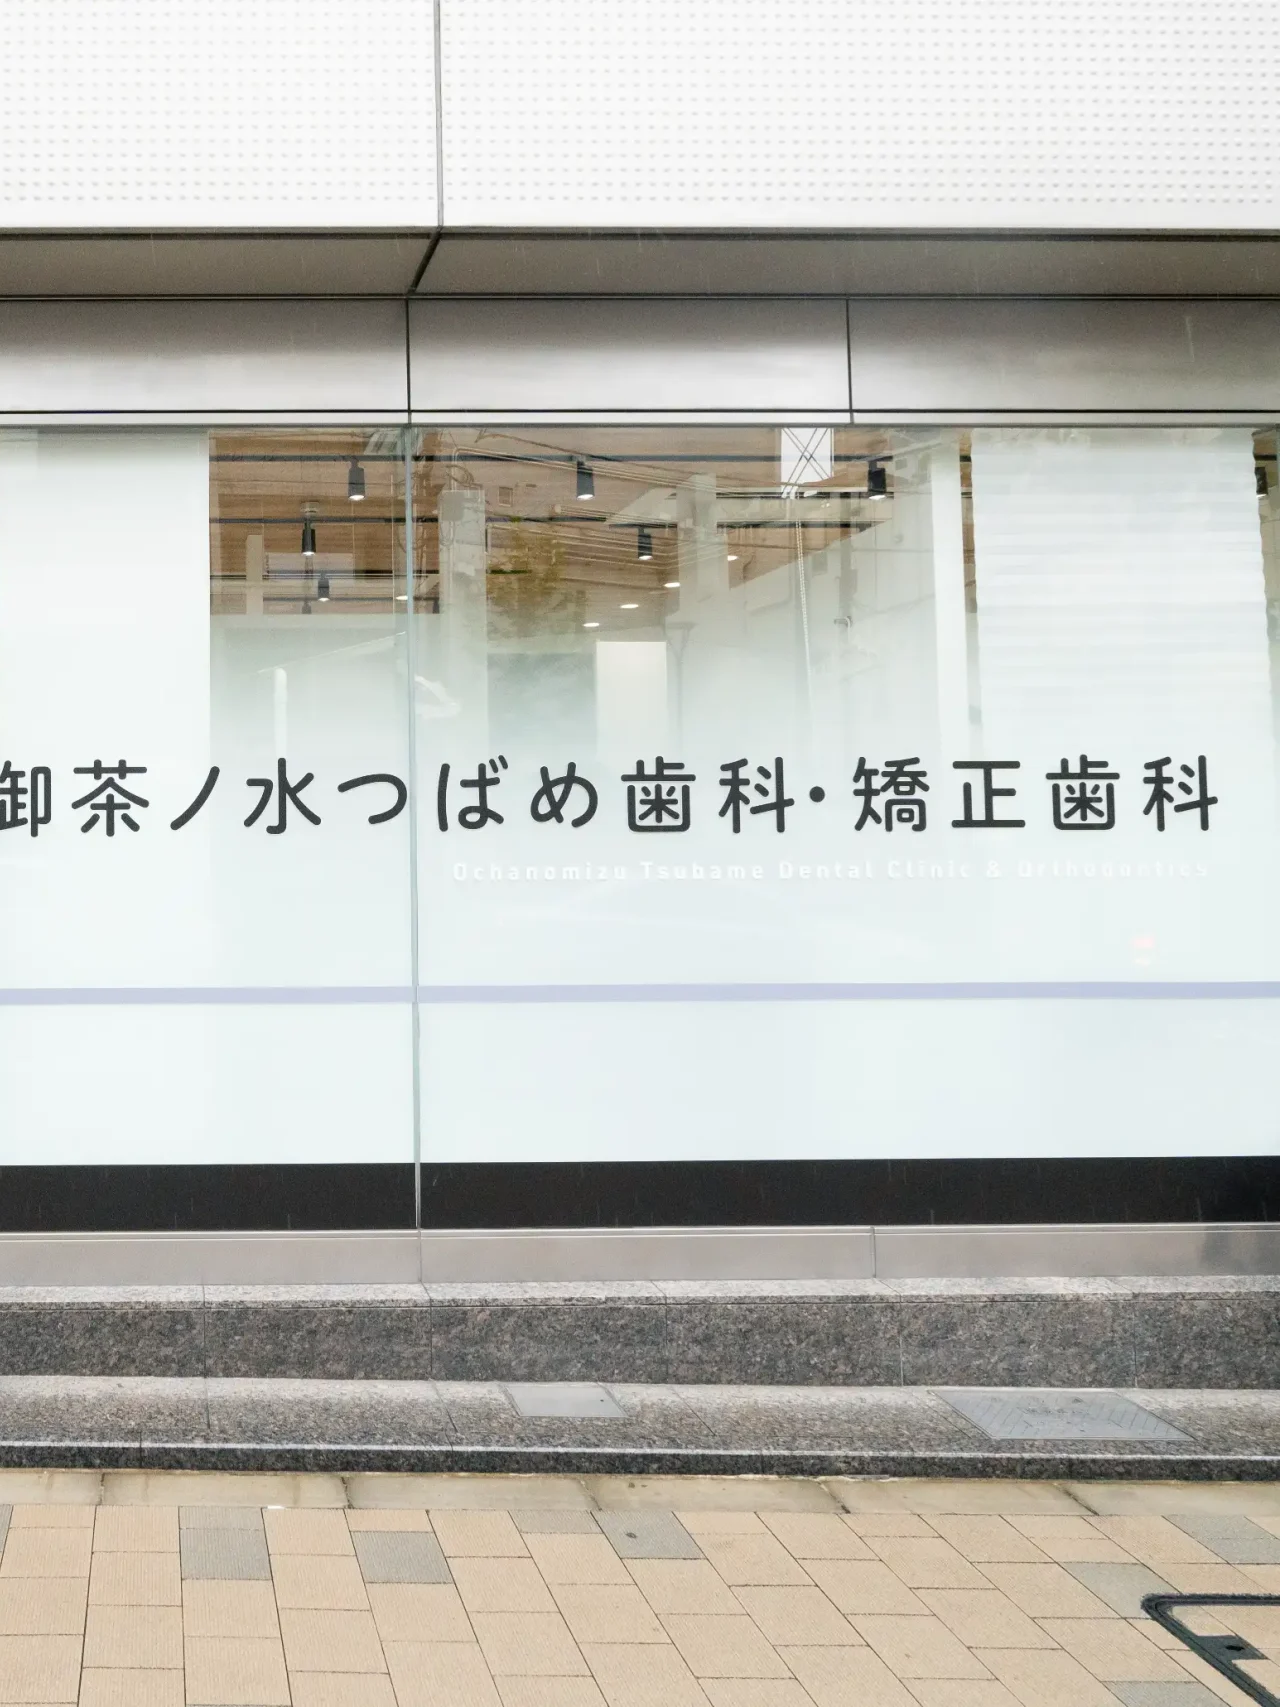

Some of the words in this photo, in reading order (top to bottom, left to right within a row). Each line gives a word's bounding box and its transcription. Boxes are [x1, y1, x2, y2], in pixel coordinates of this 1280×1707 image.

[453, 863, 626, 881] Ochanomizu
[640, 862, 764, 880] Tsubame
[780, 861, 873, 880] Dental
[887, 861, 971, 879] Clinic
[986, 860, 1002, 879] &
